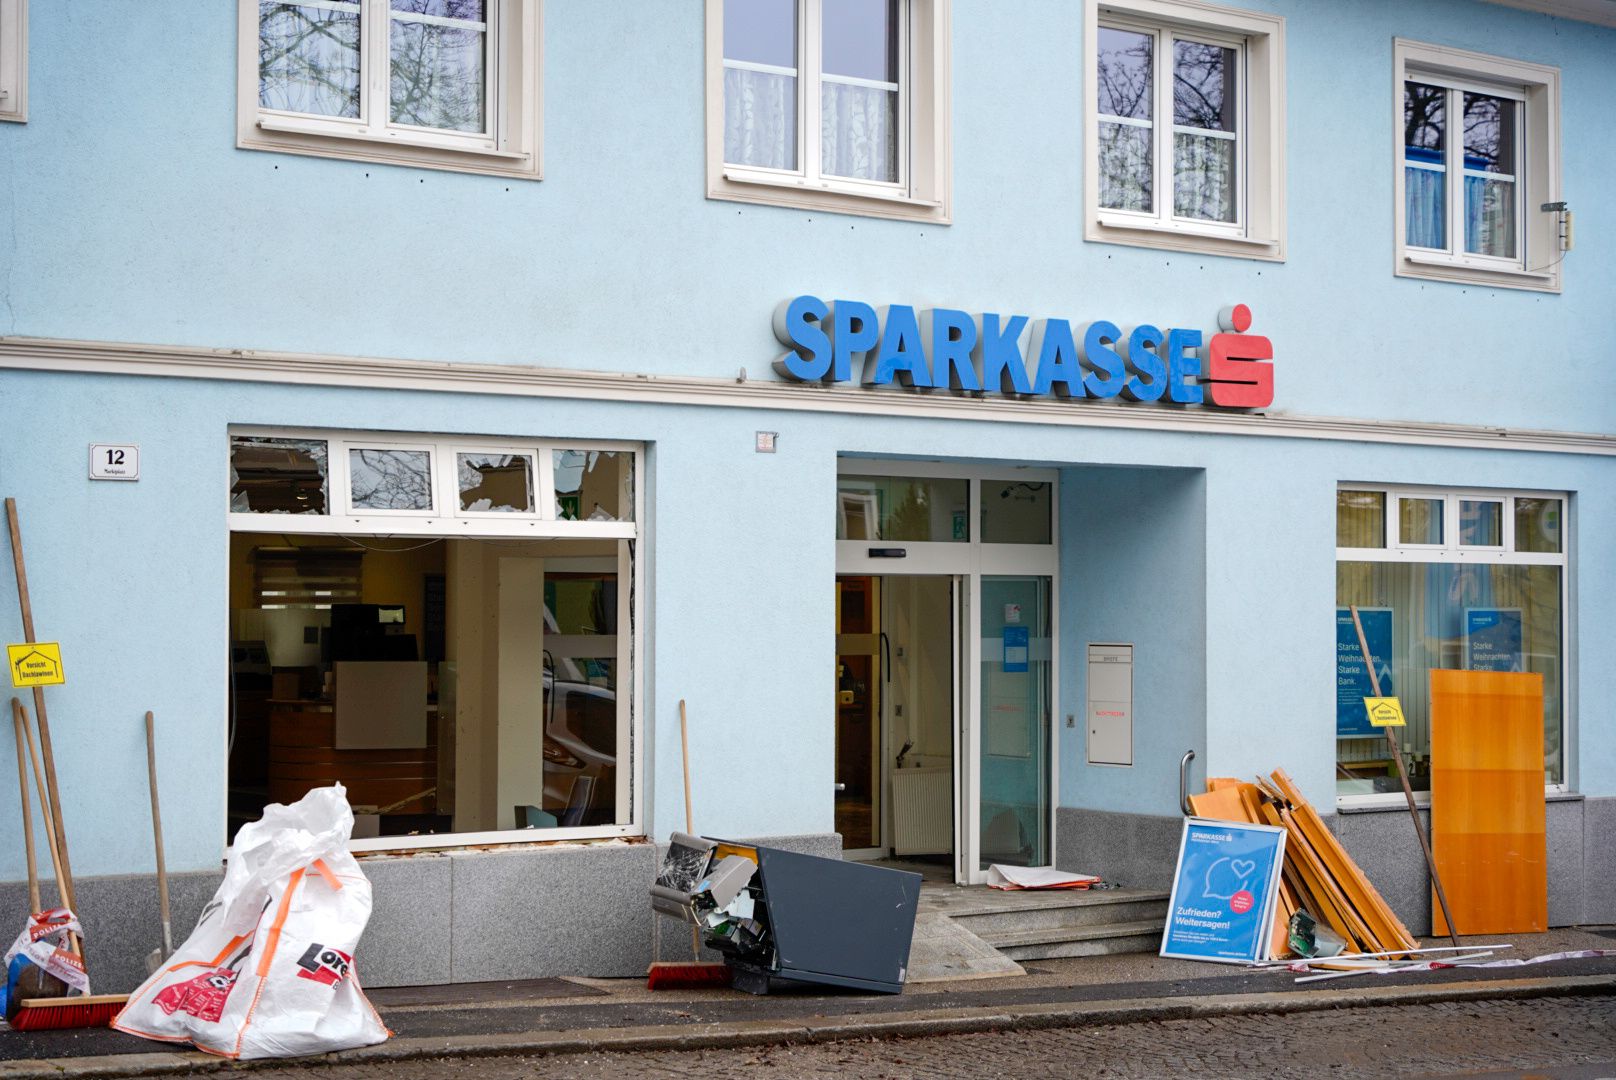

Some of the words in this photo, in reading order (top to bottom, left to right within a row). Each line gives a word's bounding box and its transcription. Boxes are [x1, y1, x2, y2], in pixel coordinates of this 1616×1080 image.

[784, 295, 1205, 404] SPARKASSE
[106, 449, 125, 465] 12
[1338, 643, 1360, 651] Starke
[1191, 832, 1226, 841] SPARKASSE
[1177, 906, 1222, 919] Zufrieden?
[1175, 916, 1231, 930] Weitersagen!
